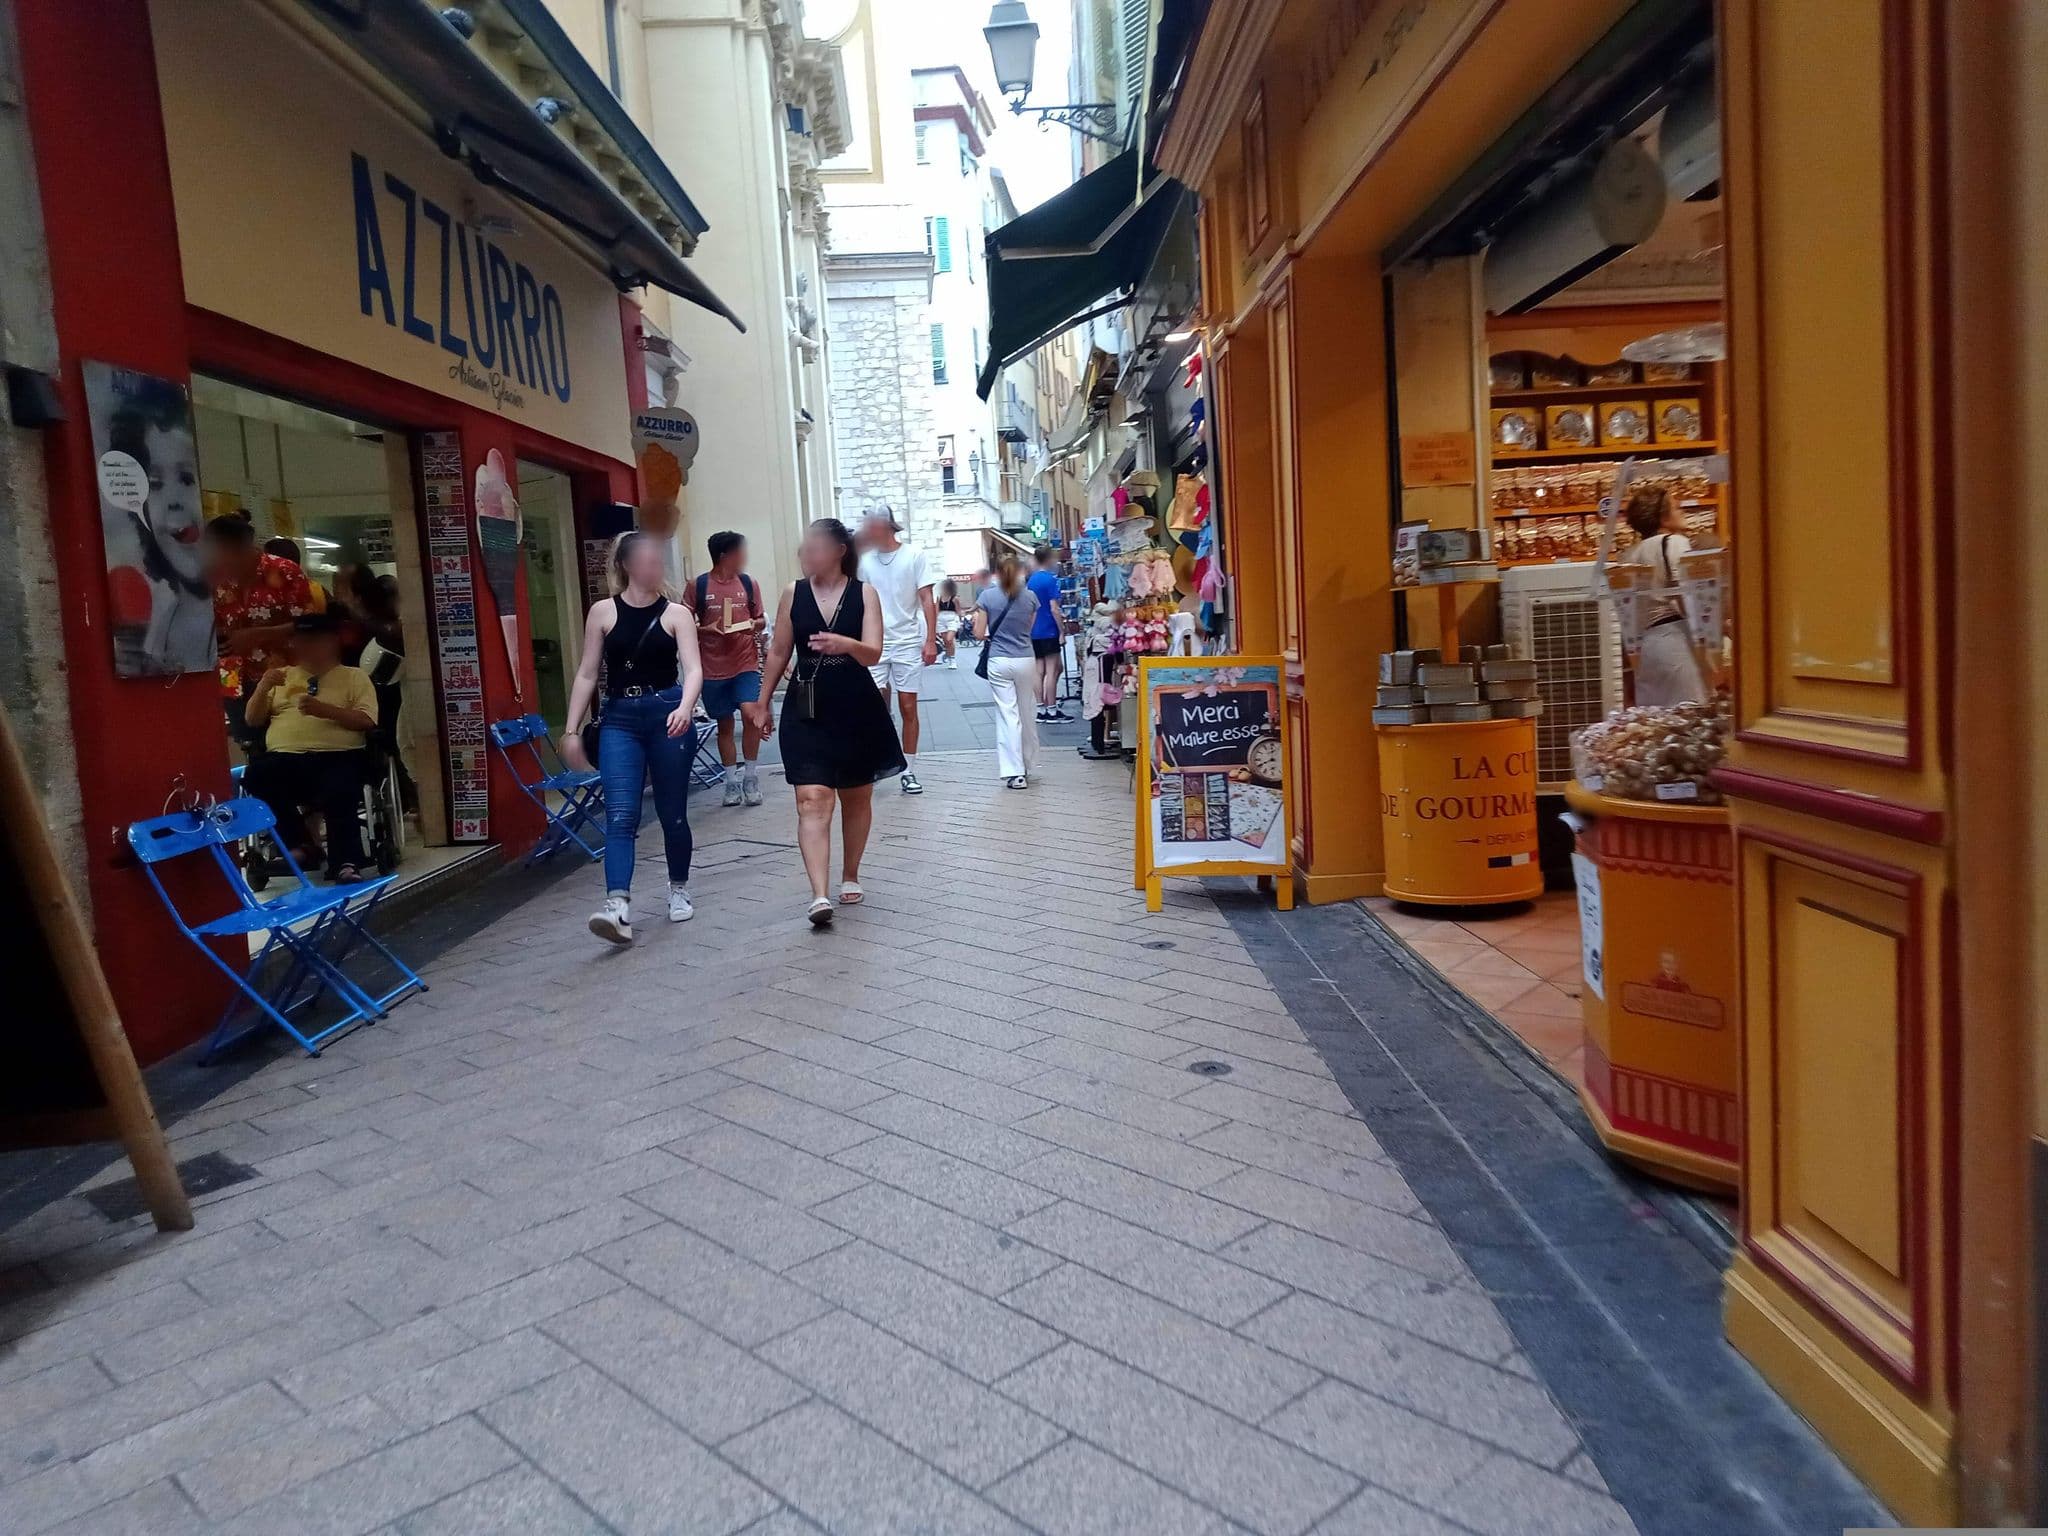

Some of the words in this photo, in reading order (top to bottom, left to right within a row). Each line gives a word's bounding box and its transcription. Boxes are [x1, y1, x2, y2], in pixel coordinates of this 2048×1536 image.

[351, 152, 571, 403] AZZURRO
[636, 415, 692, 433] AZZURRO
[1182, 700, 1240, 727] Merci
[1169, 724, 1261, 749] Maître.esse
[1452, 756, 1496, 780] LA
